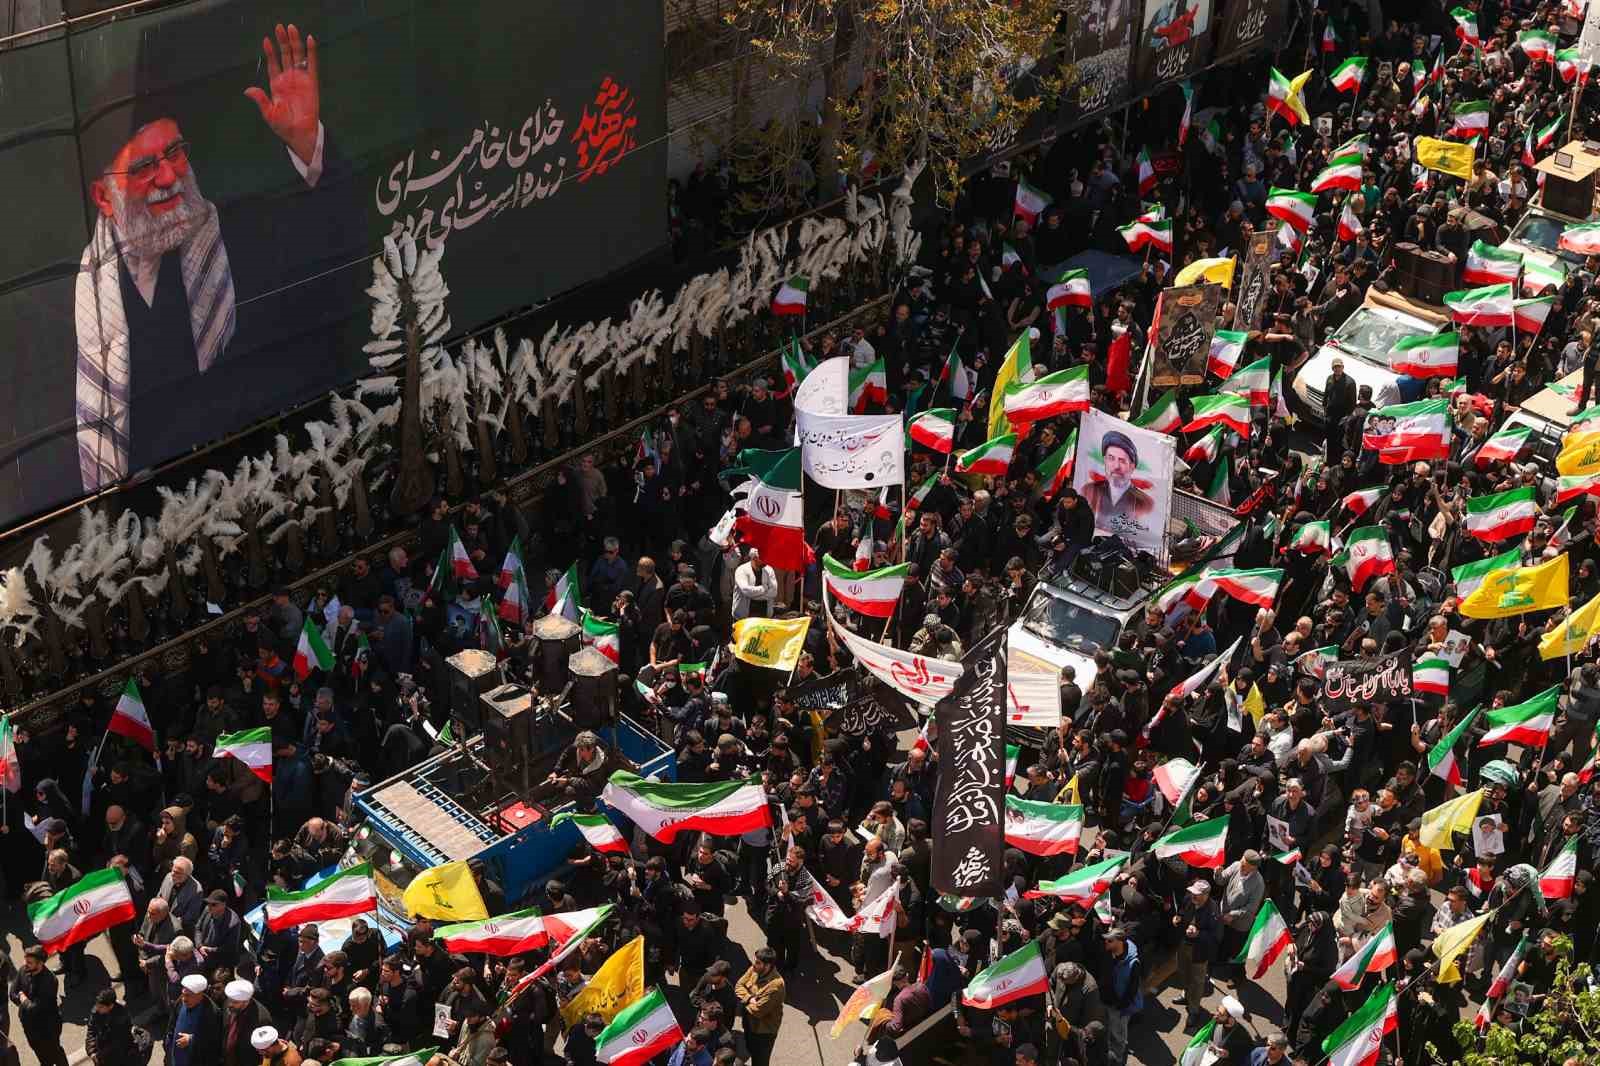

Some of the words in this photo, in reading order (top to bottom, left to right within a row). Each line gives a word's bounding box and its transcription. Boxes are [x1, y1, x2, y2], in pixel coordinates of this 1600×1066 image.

[453, 172, 523, 231] است
[519, 156, 567, 208] زنده
[1399, 667, 1411, 696] یا
